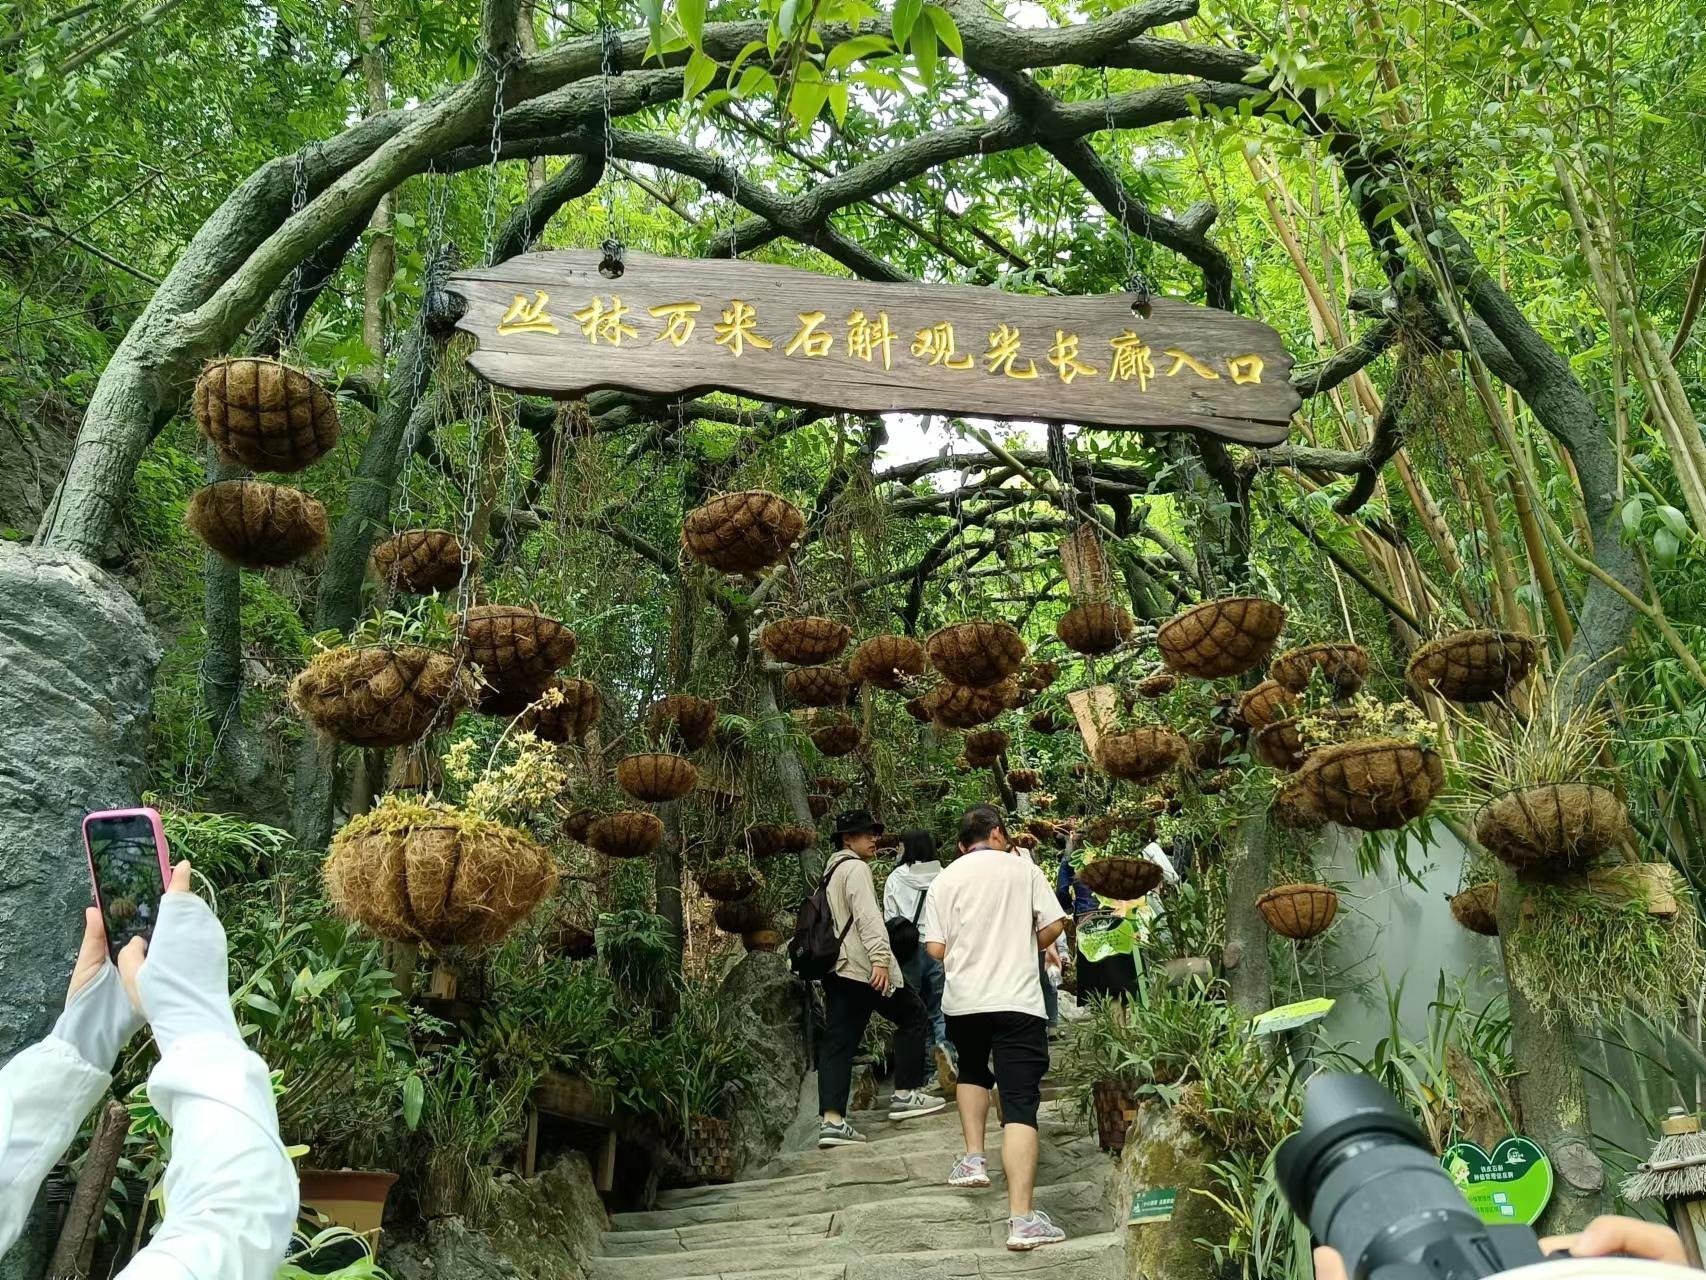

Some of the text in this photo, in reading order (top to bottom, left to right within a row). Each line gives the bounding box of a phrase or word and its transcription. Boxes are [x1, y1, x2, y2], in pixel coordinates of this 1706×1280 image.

[496, 289, 1265, 393] 丛林万米石斛观光长廊入口
